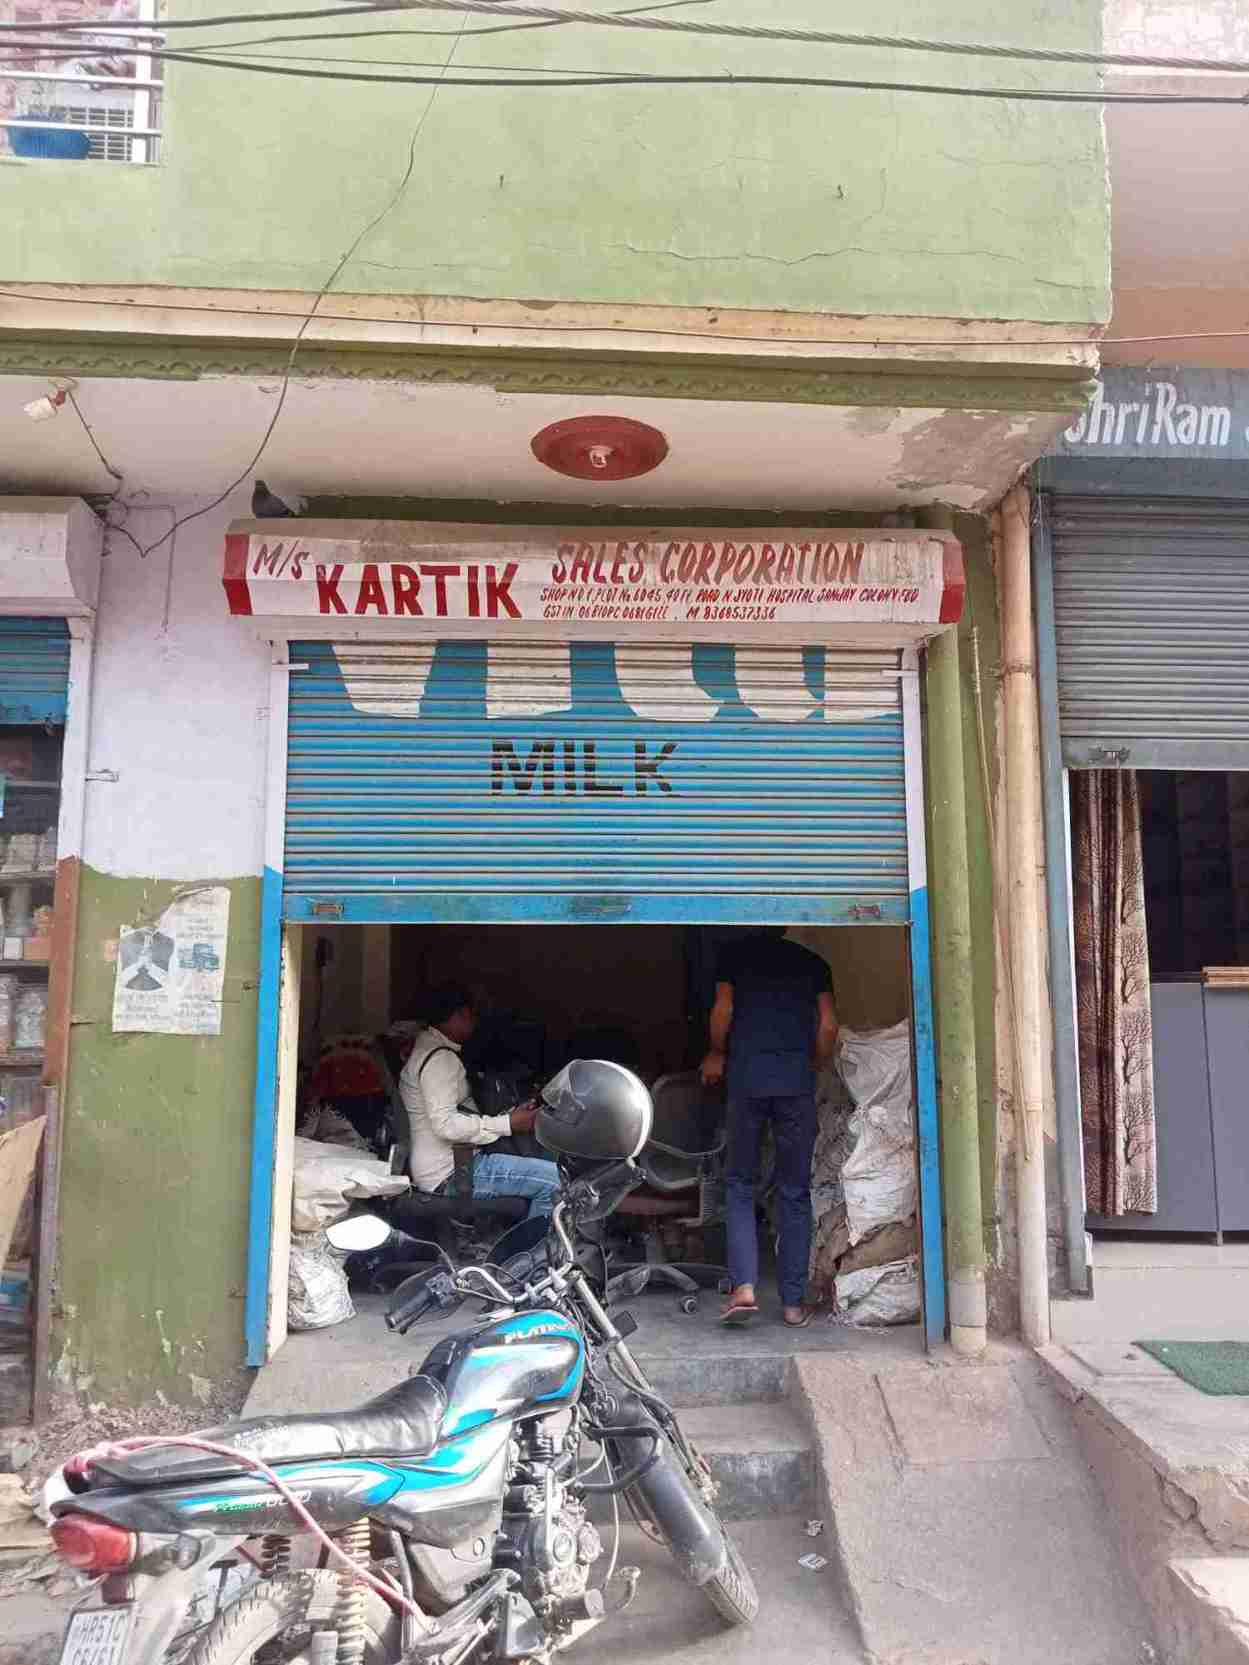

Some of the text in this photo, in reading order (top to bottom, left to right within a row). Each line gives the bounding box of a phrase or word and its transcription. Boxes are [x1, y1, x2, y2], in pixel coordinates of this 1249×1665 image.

[315, 563, 523, 619] KARTIK
[551, 541, 649, 585] SALES
[659, 541, 865, 585] CORPORATION
[766, 588, 815, 604] HOSPITAL
[491, 738, 679, 797] MILK
